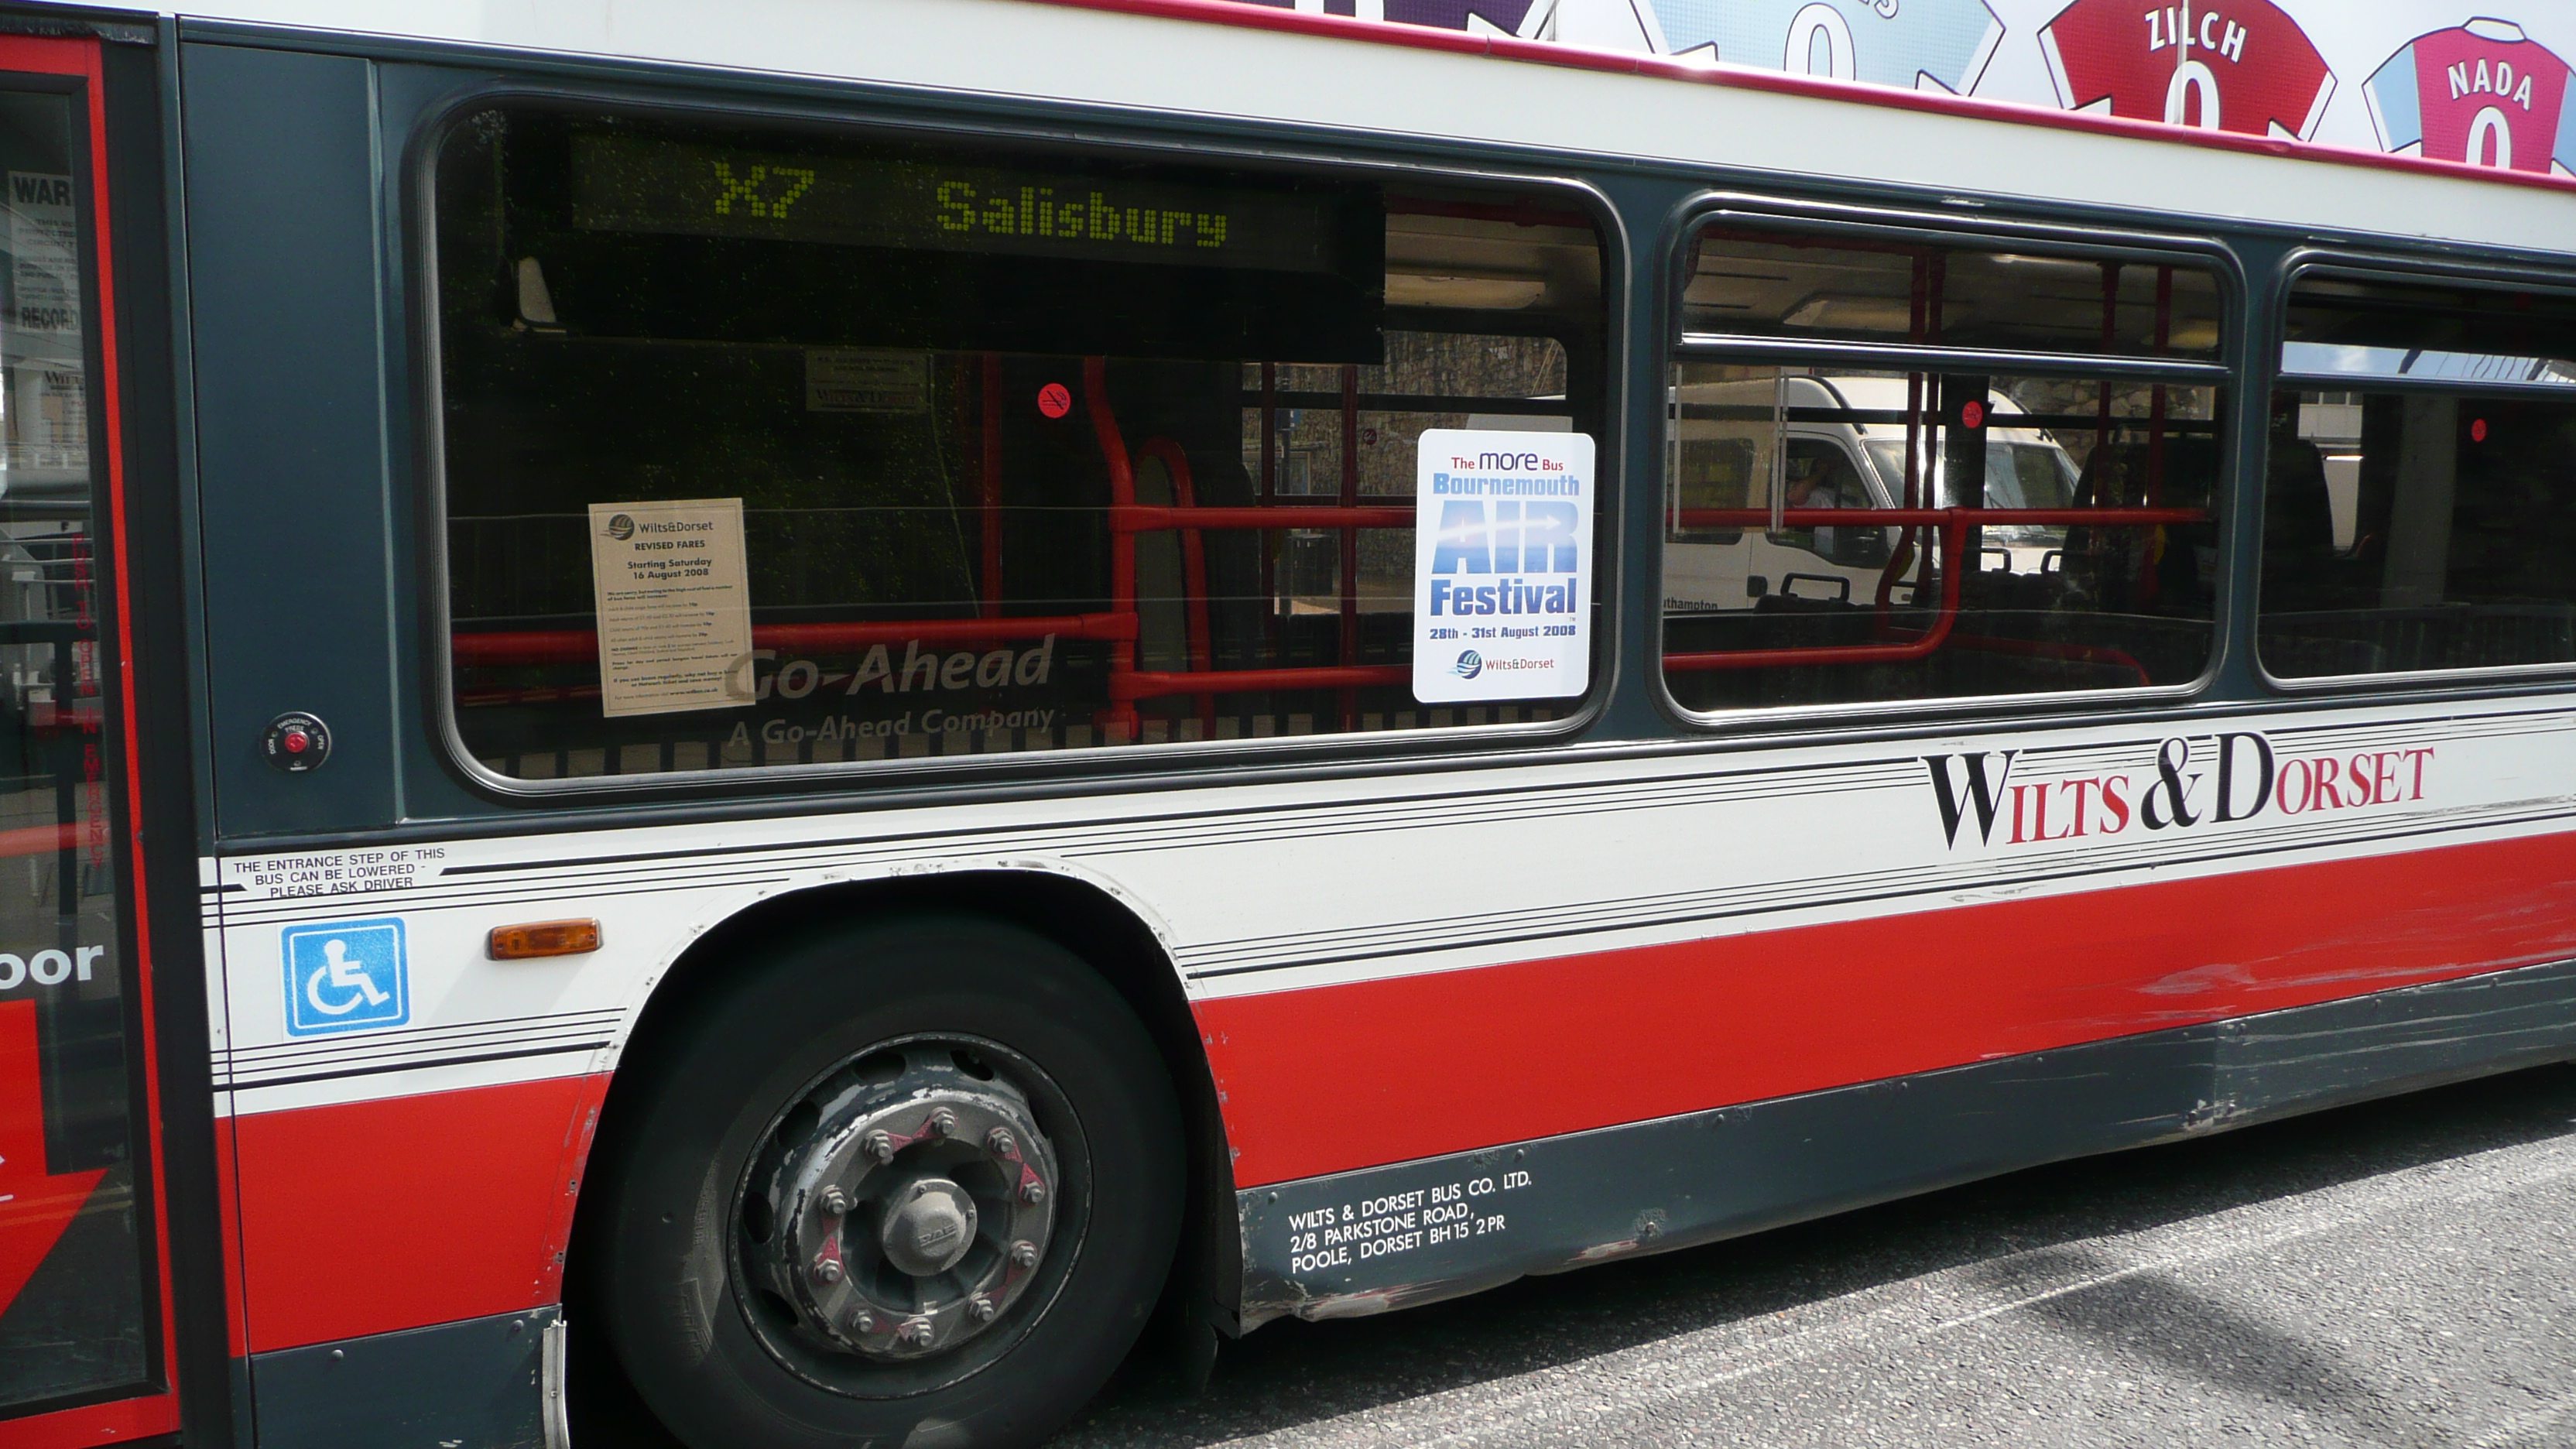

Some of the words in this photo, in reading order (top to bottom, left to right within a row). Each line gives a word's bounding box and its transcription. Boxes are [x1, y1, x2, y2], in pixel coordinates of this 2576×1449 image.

[2145, 6, 2247, 63] ZILCH
[2446, 58, 2534, 112] NADA
[714, 162, 816, 219] X7
[936, 180, 1228, 249] Salisbury
[1451, 457, 1475, 470] The
[1478, 452, 1539, 471] more
[1542, 458, 1564, 471] Bus
[1433, 472, 1580, 496] Bournemouth
[638, 521, 714, 534] Wilts&Dorset
[1431, 500, 1579, 574] AIR
[635, 541, 673, 551] REVISED
[677, 540, 705, 550] FARES
[627, 559, 666, 570] Starting
[668, 557, 712, 568] Saturday
[633, 571, 645, 580] 16
[647, 570, 681, 581] August
[684, 568, 709, 577] 2008
[1430, 577, 1577, 616] Festival
[1430, 628, 1459, 640] 28th
[1471, 627, 1497, 639] 31st
[1501, 625, 1540, 639] August
[1543, 625, 1577, 636] 2008
[724, 632, 1056, 701] Go-Ahead
[1485, 658, 1555, 671] Wilts&Dorset
[729, 721, 751, 748] A
[762, 711, 912, 745] Go-Ahead
[921, 707, 1056, 737] Company
[1920, 748, 2130, 851] WILTS
[2139, 736, 2203, 831] &
[2210, 730, 2436, 824] DORSET
[234, 861, 262, 873] THE
[267, 855, 344, 872] ENTRANCE
[349, 852, 385, 865] STEP
[390, 851, 409, 862] OF
[415, 848, 446, 860] THIS
[255, 872, 284, 886] BUS
[290, 870, 320, 883] CAN
[325, 868, 343, 881] BE
[348, 863, 416, 879] LOWERED
[270, 885, 324, 899] PLEASE
[330, 881, 358, 895] ASK
[364, 877, 414, 891] DRIVER
[1288, 1208, 1335, 1232] WILTS
[1341, 1204, 1355, 1221] &
[1361, 1190, 1425, 1218] DORSET
[1431, 1183, 1461, 1204] BUS
[1468, 1177, 1496, 1196] CO.
[1503, 1170, 1533, 1190] LTD.
[1290, 1232, 1317, 1253] 2/8
[1324, 1213, 1416, 1246] PARKSTONE
[1423, 1202, 1475, 1227] ROAD,
[1291, 1246, 1352, 1274] POOLE,
[1360, 1231, 1423, 1259] DORSET
